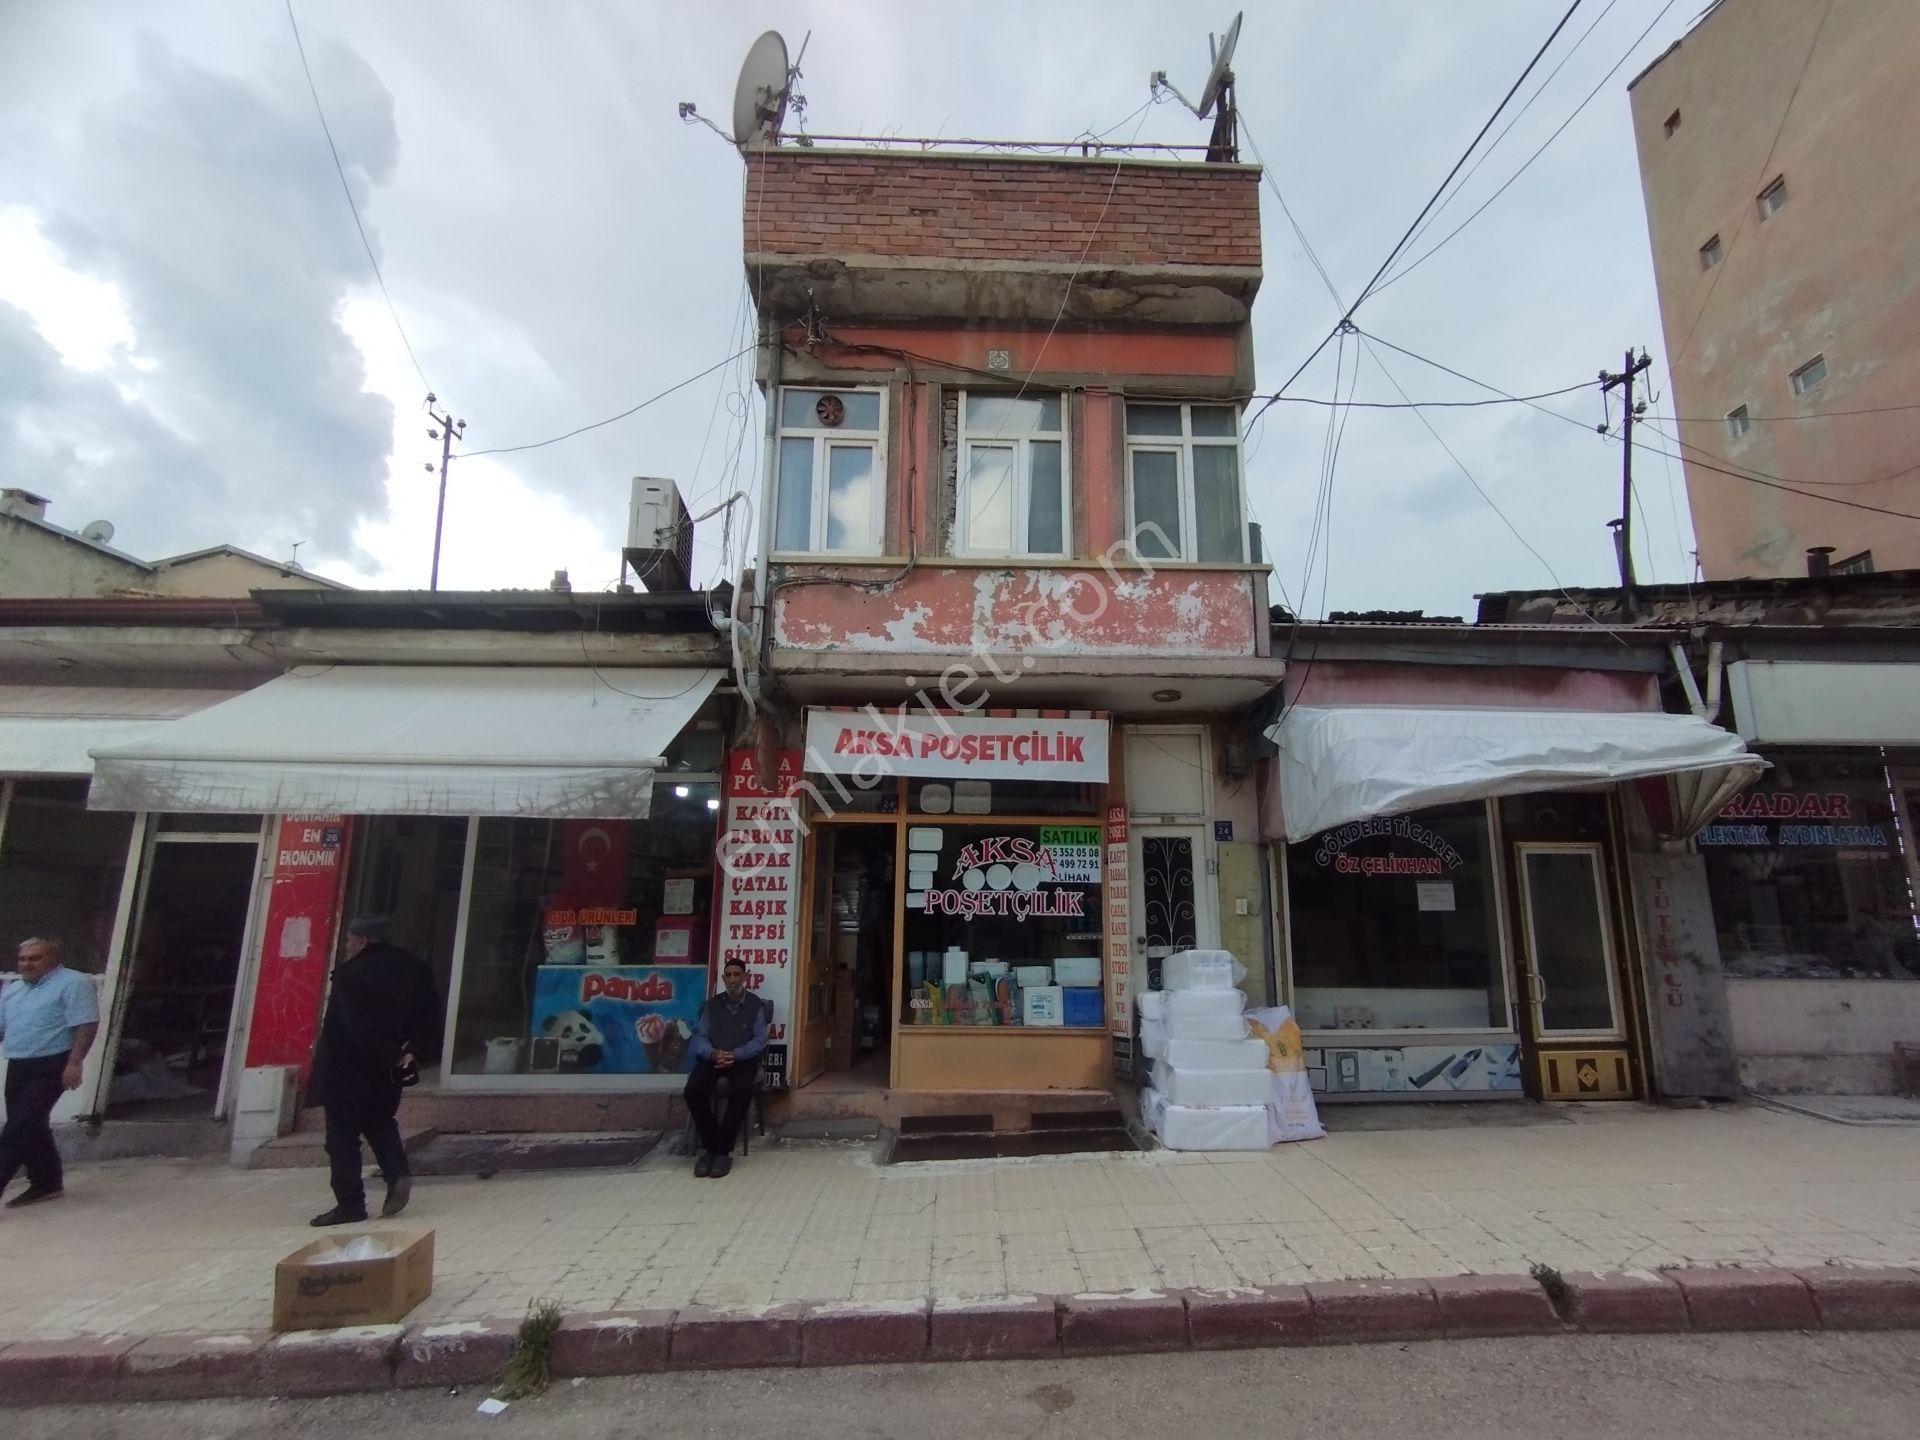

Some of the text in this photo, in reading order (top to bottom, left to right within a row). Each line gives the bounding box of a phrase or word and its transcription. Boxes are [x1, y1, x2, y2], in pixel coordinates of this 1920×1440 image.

[834, 728, 1085, 765] AKSA POŞETÇİLİK
[740, 757, 792, 771] AA
[733, 774, 797, 795] POET
[735, 801, 792, 821] KAĞIT
[303, 828, 321, 843] EN
[326, 833, 338, 842] 26
[730, 829, 794, 844] BARDAK
[1042, 830, 1099, 844] SATILIK
[1218, 827, 1230, 835] 24
[1393, 816, 1463, 870] TİCARET
[732, 852, 791, 868] TABAK
[952, 836, 1057, 881] AKSA
[1059, 848, 1075, 858] 352
[1076, 848, 1087, 858] 05
[1088, 848, 1099, 858] 08
[1059, 860, 1076, 869] 499
[1077, 860, 1088, 869] 72
[1088, 860, 1099, 869] 91
[1335, 852, 1442, 877] ÖZ ÇELİKHAN
[731, 876, 788, 896] ÇATAL
[729, 900, 788, 920] KAŞIK
[924, 887, 1085, 922] POŞETÇİLİK
[729, 919, 786, 940] TEPSİ
[1115, 1003, 1127, 1014] VE
